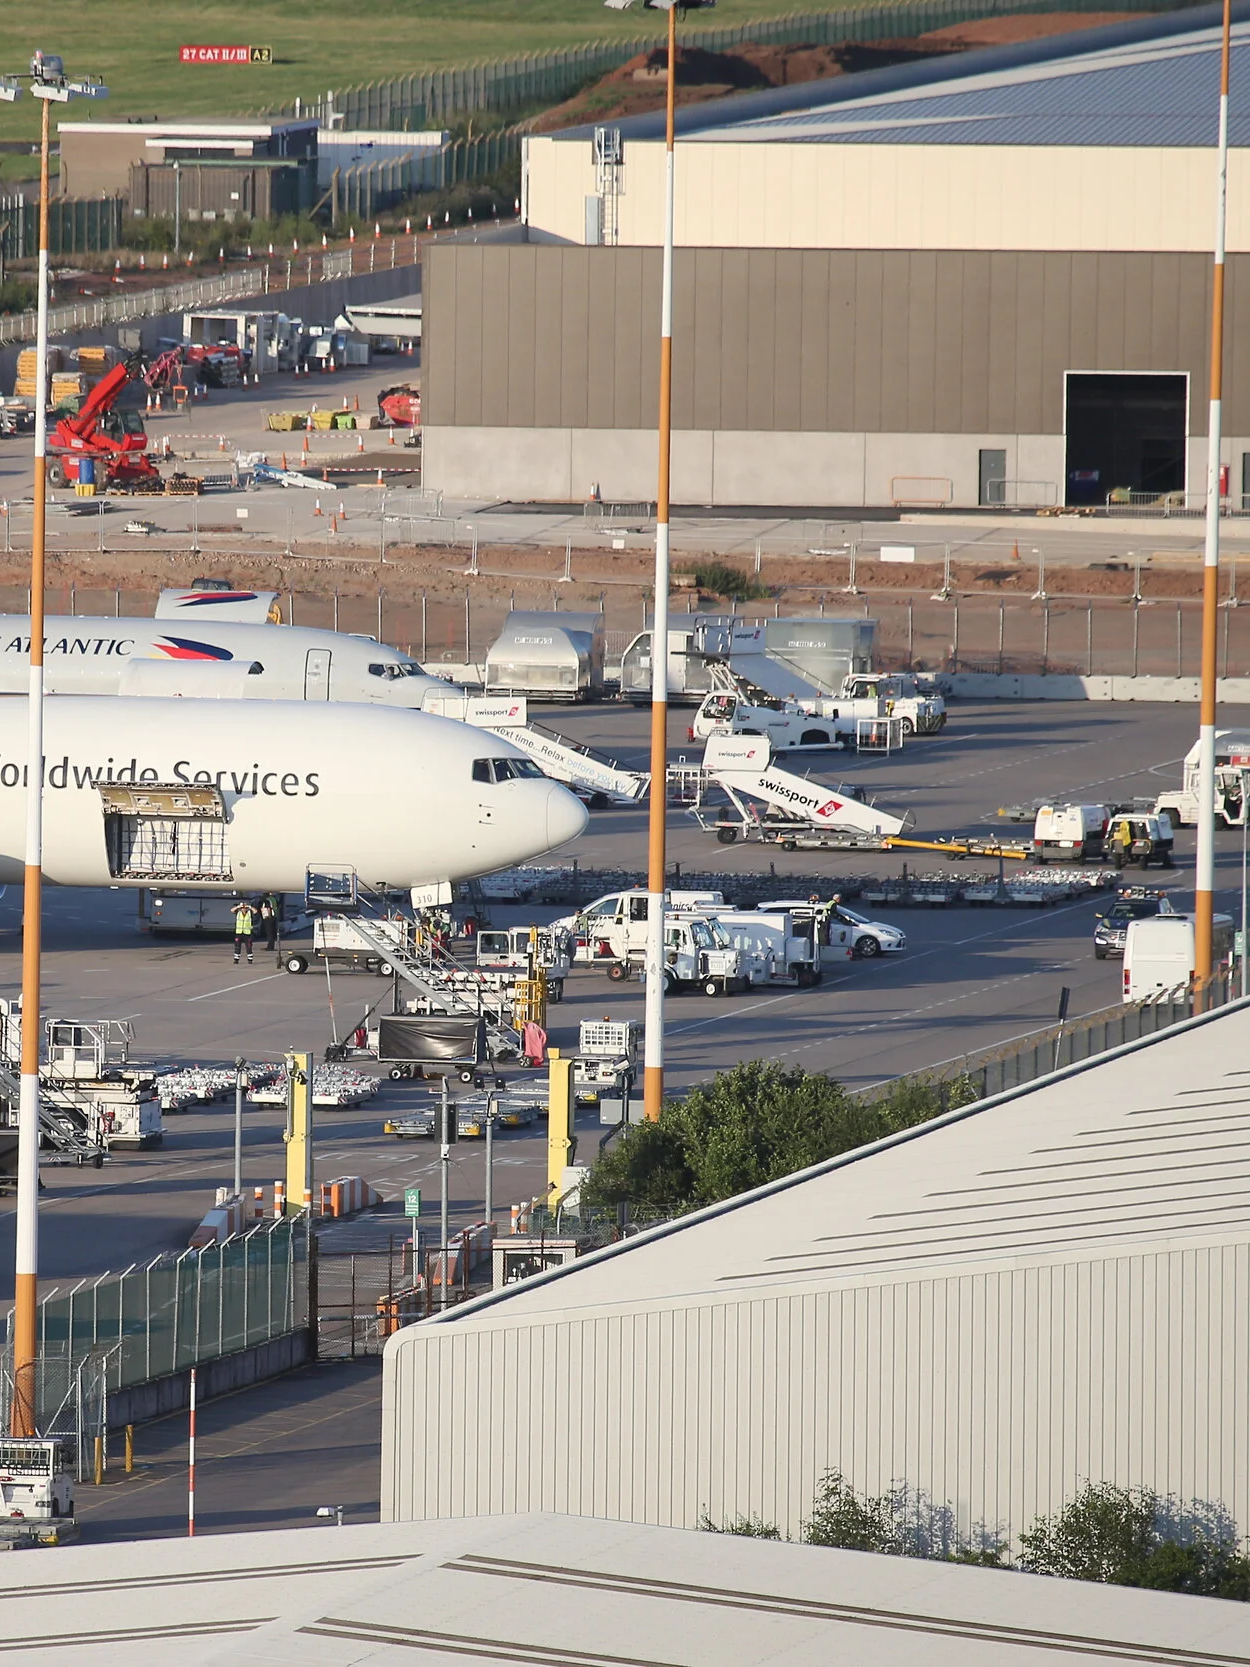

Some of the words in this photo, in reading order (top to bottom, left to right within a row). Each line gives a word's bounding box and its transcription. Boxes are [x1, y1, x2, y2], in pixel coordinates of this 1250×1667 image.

[182, 48, 196, 60] 27
[199, 48, 219, 60] CAT
[253, 49, 269, 60] A2
[475, 708, 508, 717] swissport
[718, 751, 747, 759] swissport
[173, 760, 320, 797] Services
[758, 777, 819, 809] swissport
[416, 894, 433, 905] 310
[407, 1195, 417, 1203] 12
